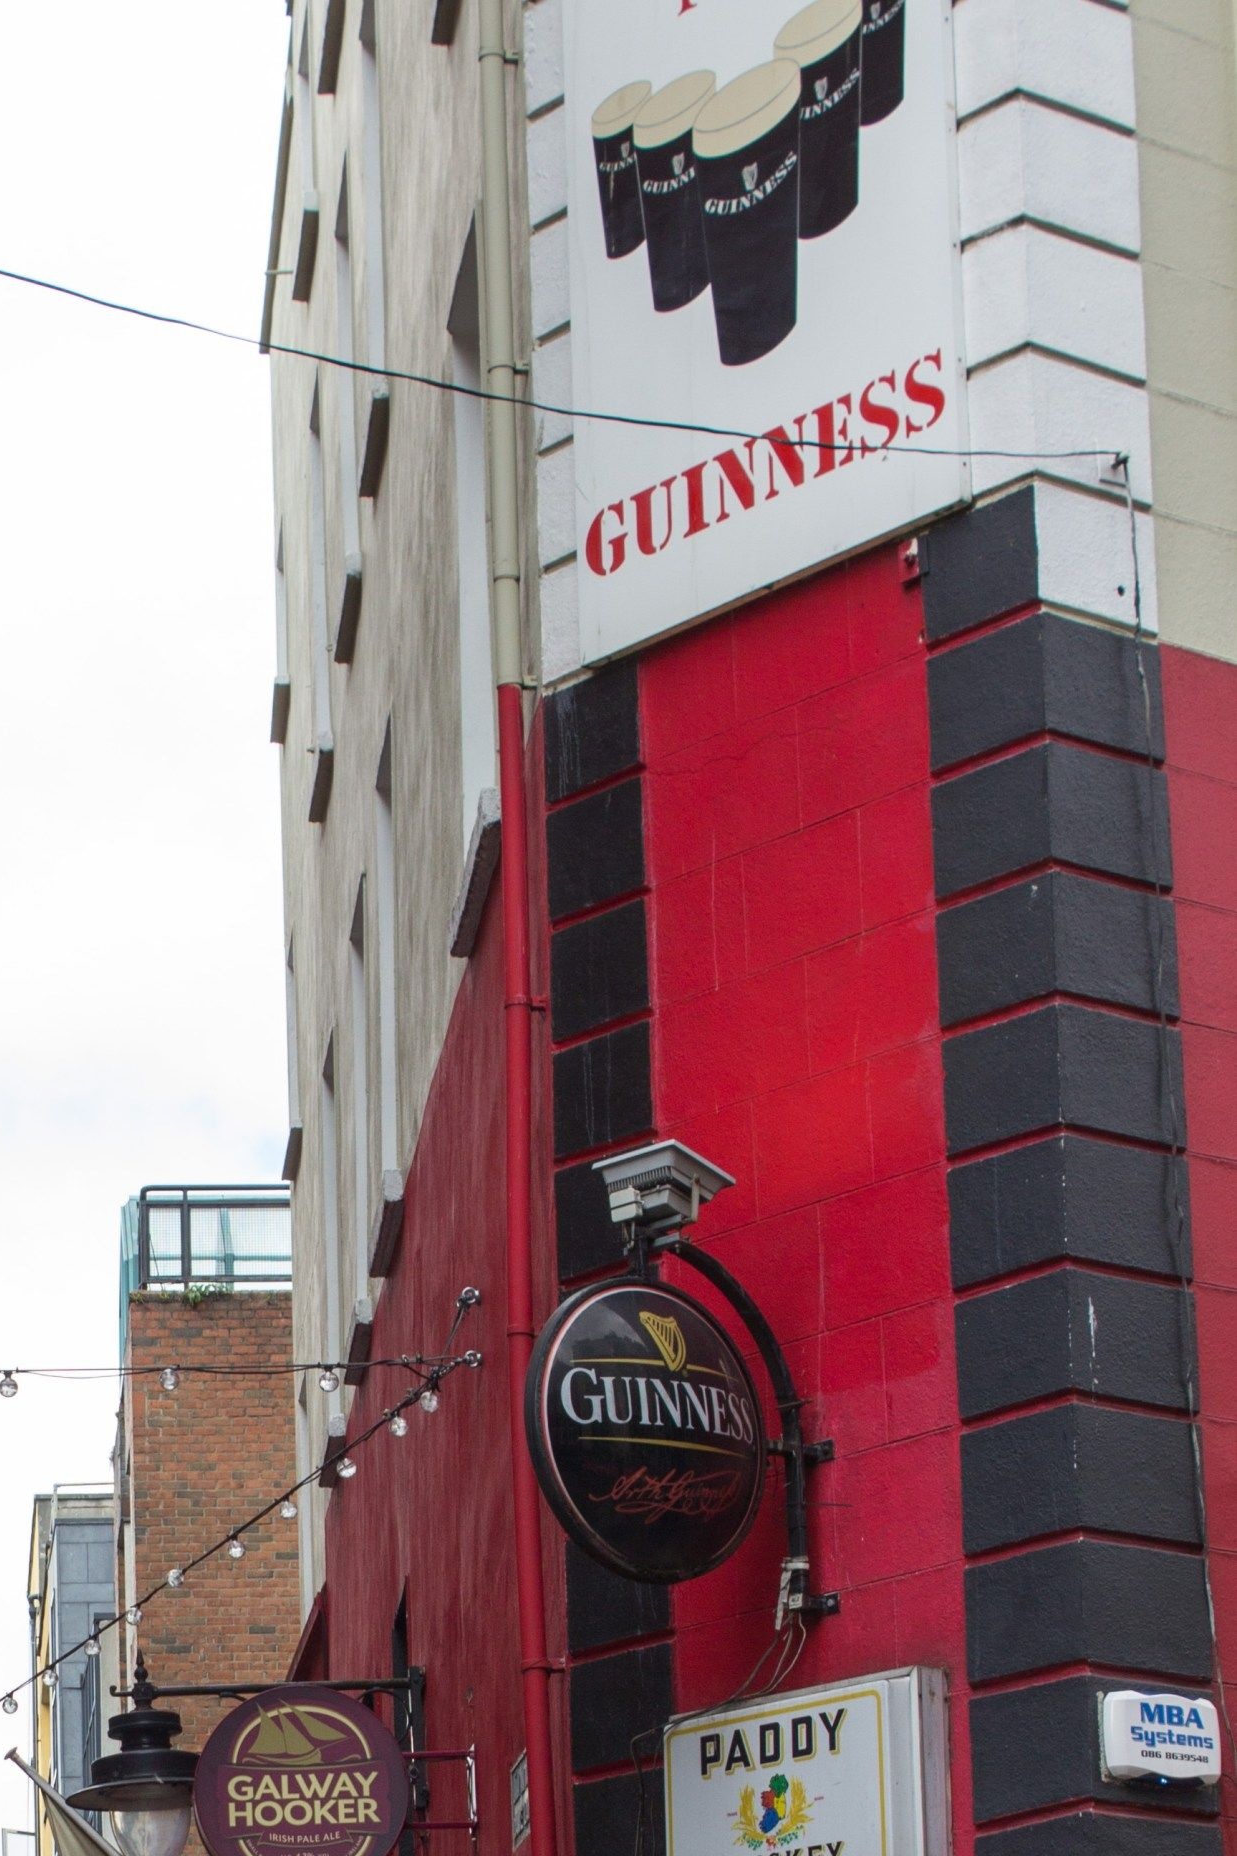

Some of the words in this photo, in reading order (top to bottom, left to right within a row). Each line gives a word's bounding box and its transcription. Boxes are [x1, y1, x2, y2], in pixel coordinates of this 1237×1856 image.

[704, 151, 798, 216] GUINNESS
[585, 348, 946, 577] GUINNESS
[560, 1367, 754, 1445] GUINNESS
[1140, 1702, 1205, 1729] MBA
[700, 1708, 847, 1779] PADDY
[1130, 1726, 1214, 1750] Systems
[1141, 1750, 1162, 1759] 086
[1165, 1752, 1209, 1764] 8639548
[227, 1771, 378, 1801] GALWAY
[228, 1798, 382, 1828] HOOKER
[269, 1833, 295, 1844] IRISH
[297, 1834, 320, 1844] PALE
[323, 1831, 341, 1841] ALE
